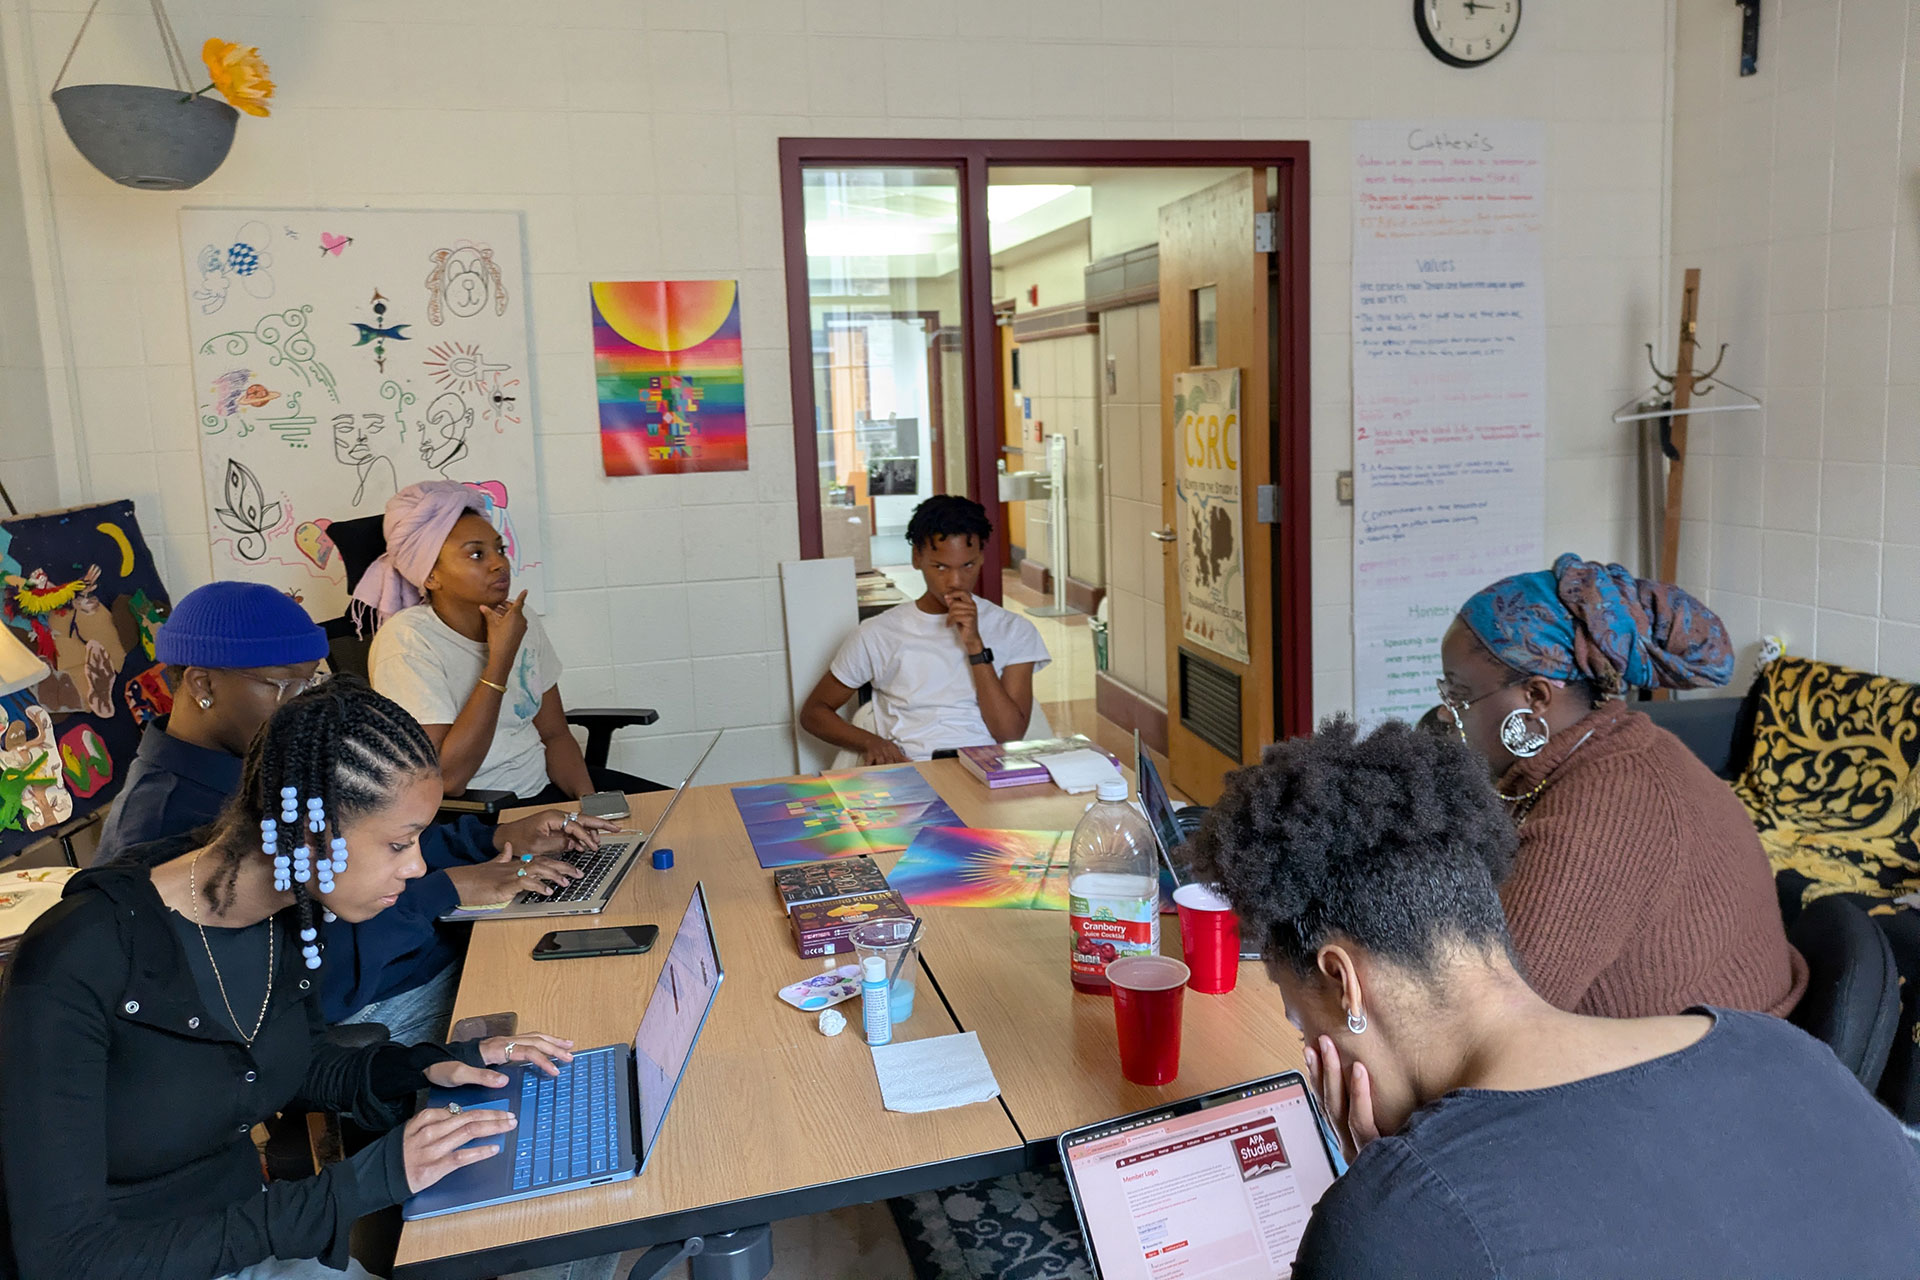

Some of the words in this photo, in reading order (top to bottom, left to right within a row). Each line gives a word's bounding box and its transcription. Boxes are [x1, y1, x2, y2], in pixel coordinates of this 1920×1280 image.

[1184, 414, 1237, 470] CSRC
[1083, 921, 1127, 934] Cranberry
[1101, 931, 1125, 940] Cocktail
[1249, 1134, 1265, 1146] APA
[1240, 1140, 1279, 1160] Studies
[1122, 1171, 1144, 1184] Member
[1144, 1168, 1159, 1179] Login
